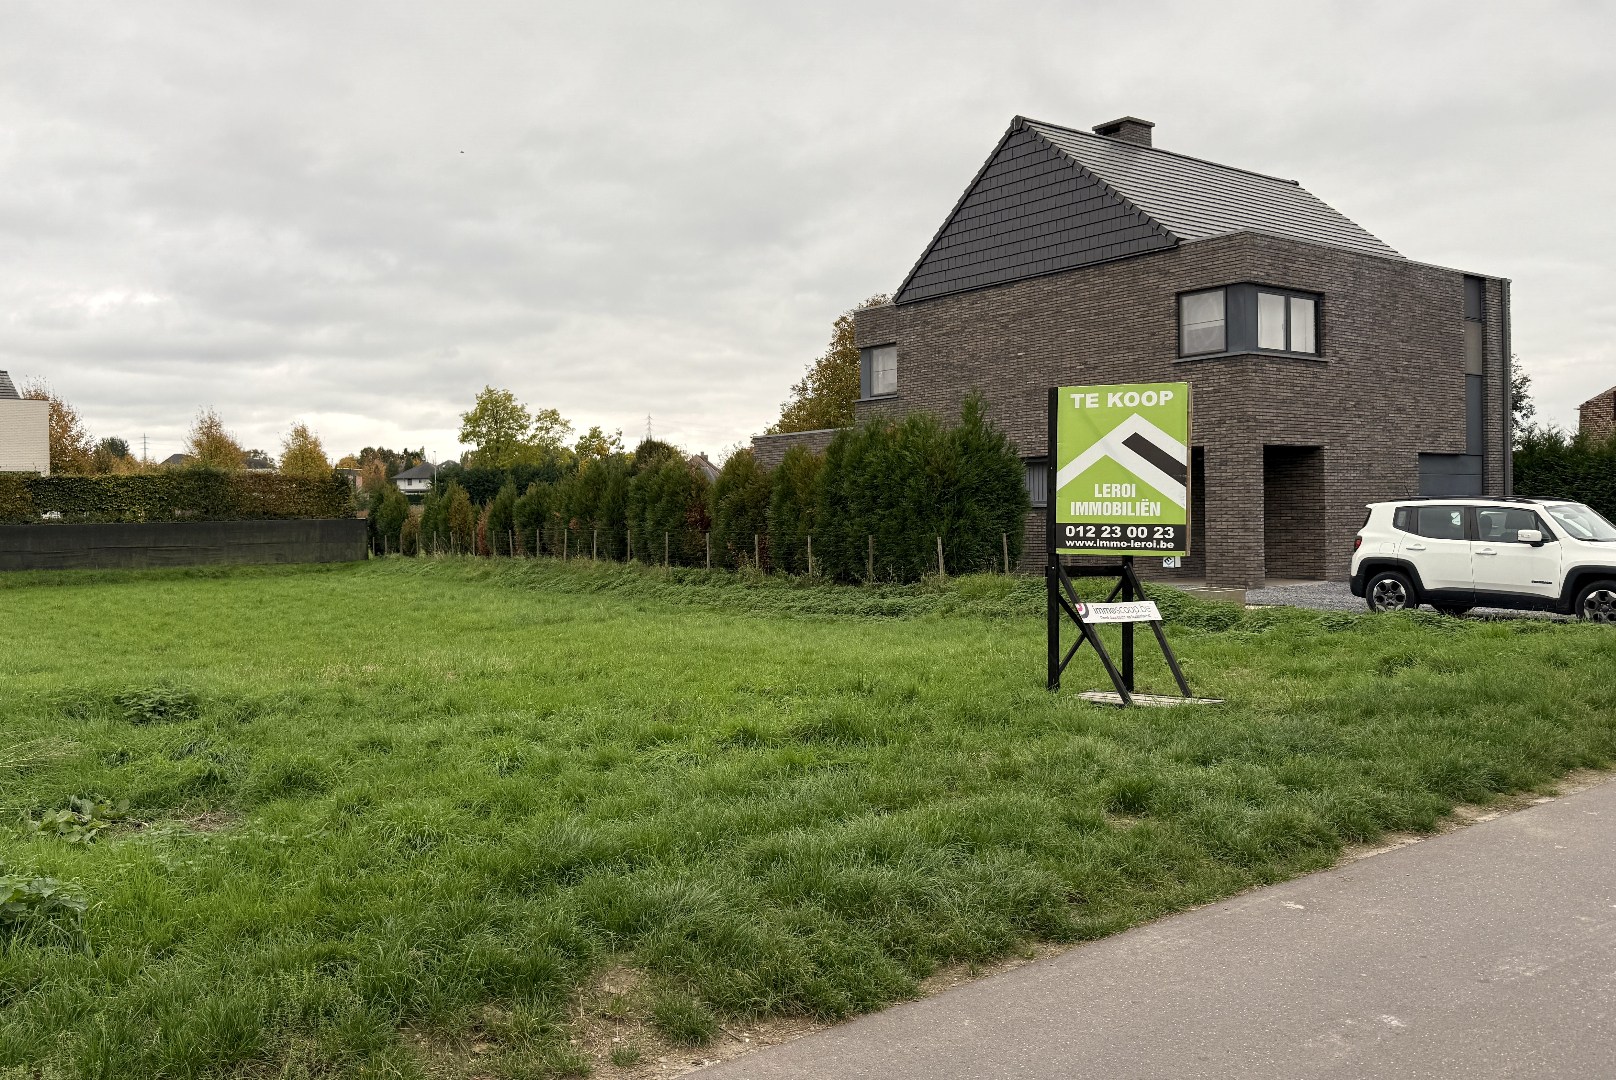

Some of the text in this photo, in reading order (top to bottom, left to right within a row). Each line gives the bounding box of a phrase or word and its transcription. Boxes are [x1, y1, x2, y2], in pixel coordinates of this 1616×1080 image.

[1070, 391, 1174, 408] TE KOOP
[1094, 483, 1136, 498] LEROI
[1070, 499, 1161, 517] IMMOBILIËN
[1065, 526, 1175, 539] 012 23 00 23
[1065, 539, 1175, 549] www.immo-leroi.be
